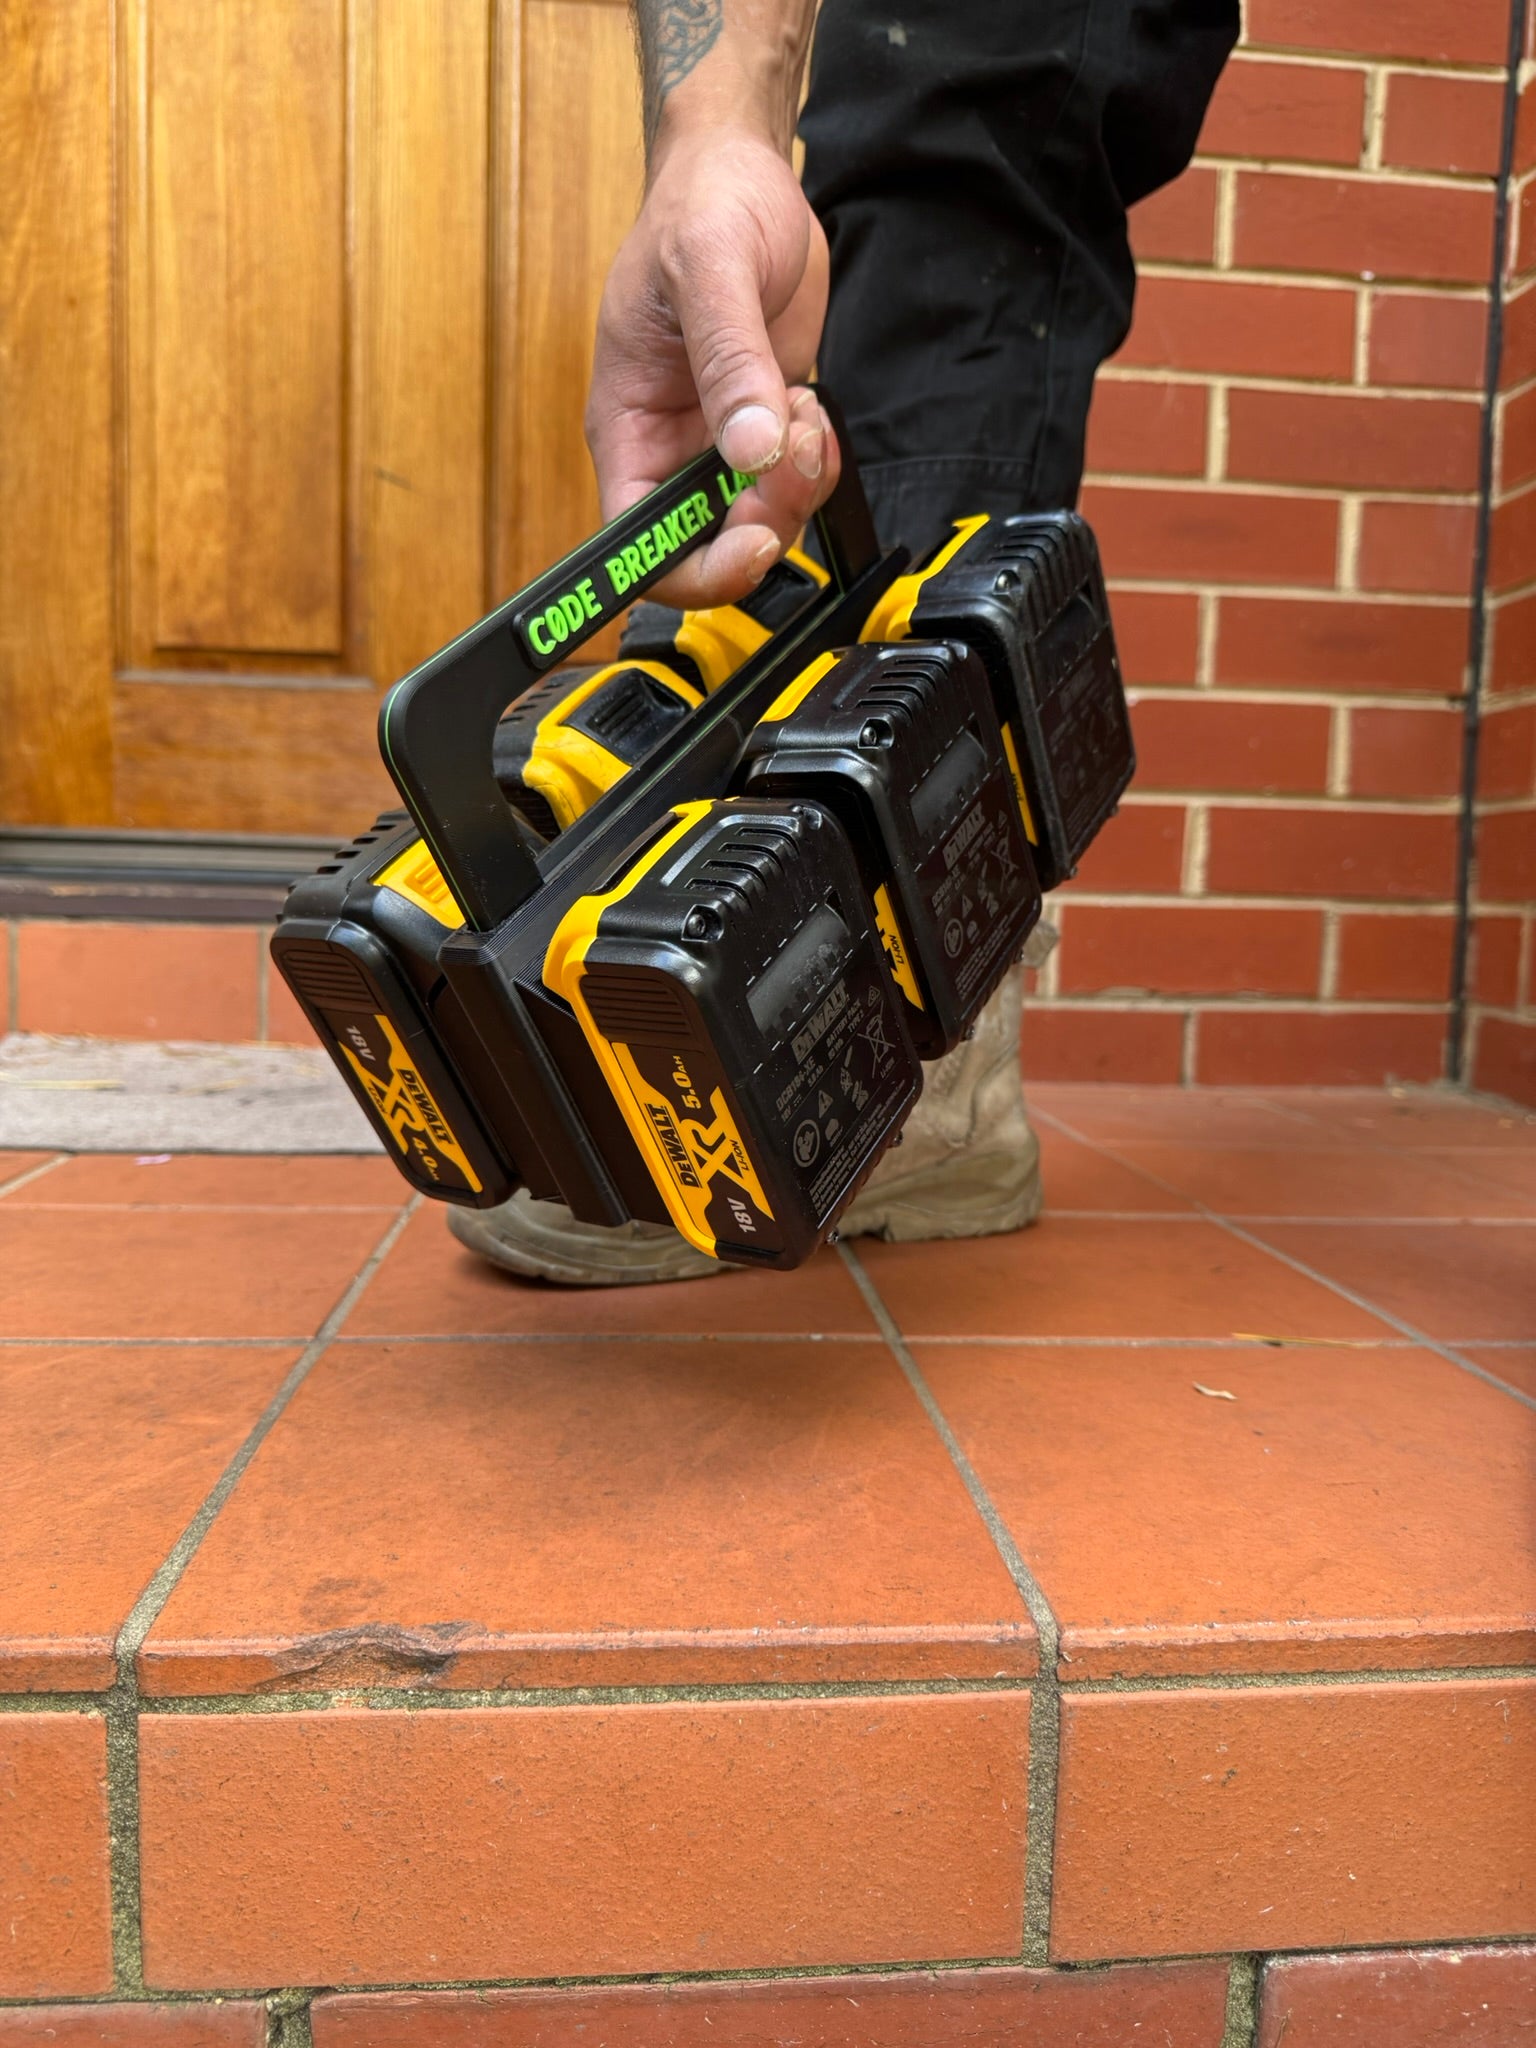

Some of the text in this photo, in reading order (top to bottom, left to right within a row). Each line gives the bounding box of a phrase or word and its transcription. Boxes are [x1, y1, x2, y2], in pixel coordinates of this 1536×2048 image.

[604, 490, 715, 595] BREAKER
[346, 1025, 376, 1062] 18V
[789, 977, 850, 1066] DEWALT
[396, 1068, 455, 1145] DEWALT
[644, 1103, 702, 1188] DEWALT
[727, 1197, 757, 1233] 18V
